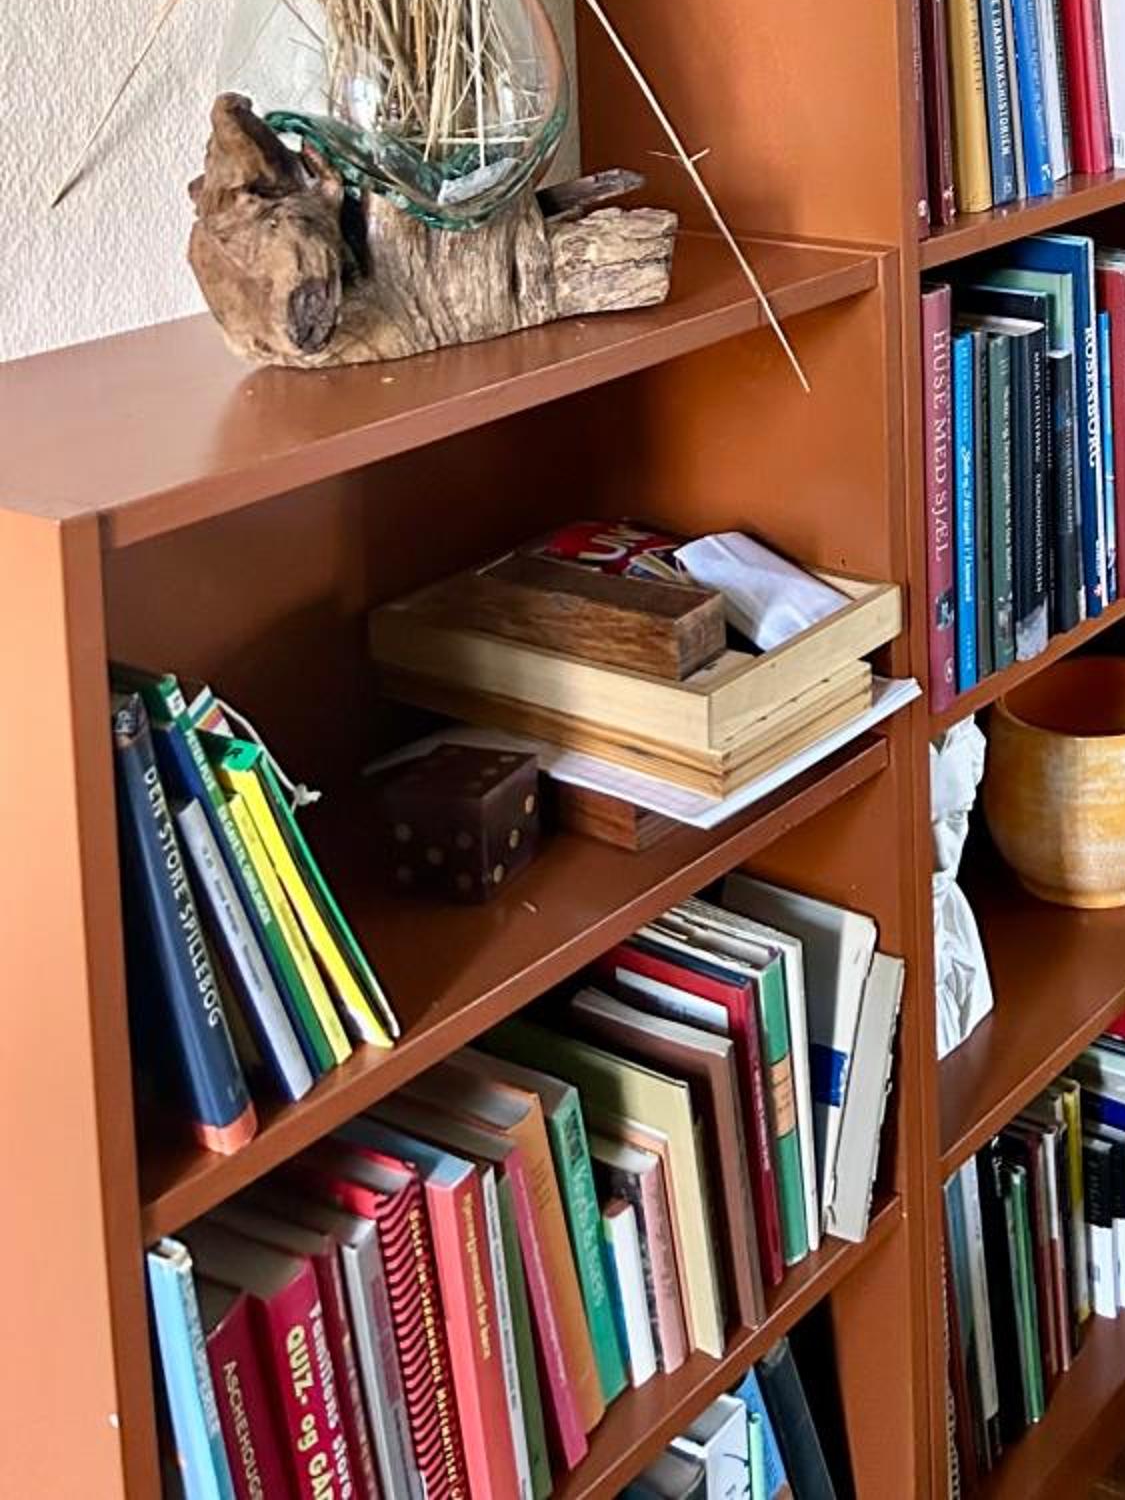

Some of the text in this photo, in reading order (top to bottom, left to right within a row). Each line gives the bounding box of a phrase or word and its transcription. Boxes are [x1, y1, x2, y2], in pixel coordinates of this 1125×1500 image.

[992, 19, 1012, 156] DANMARKSHISTORIEN
[931, 329, 951, 562] HUSE MED SJÆL
[1084, 325, 1101, 468] ROSENBORG
[143, 765, 222, 1028] DEN STORE SPILLEBOG
